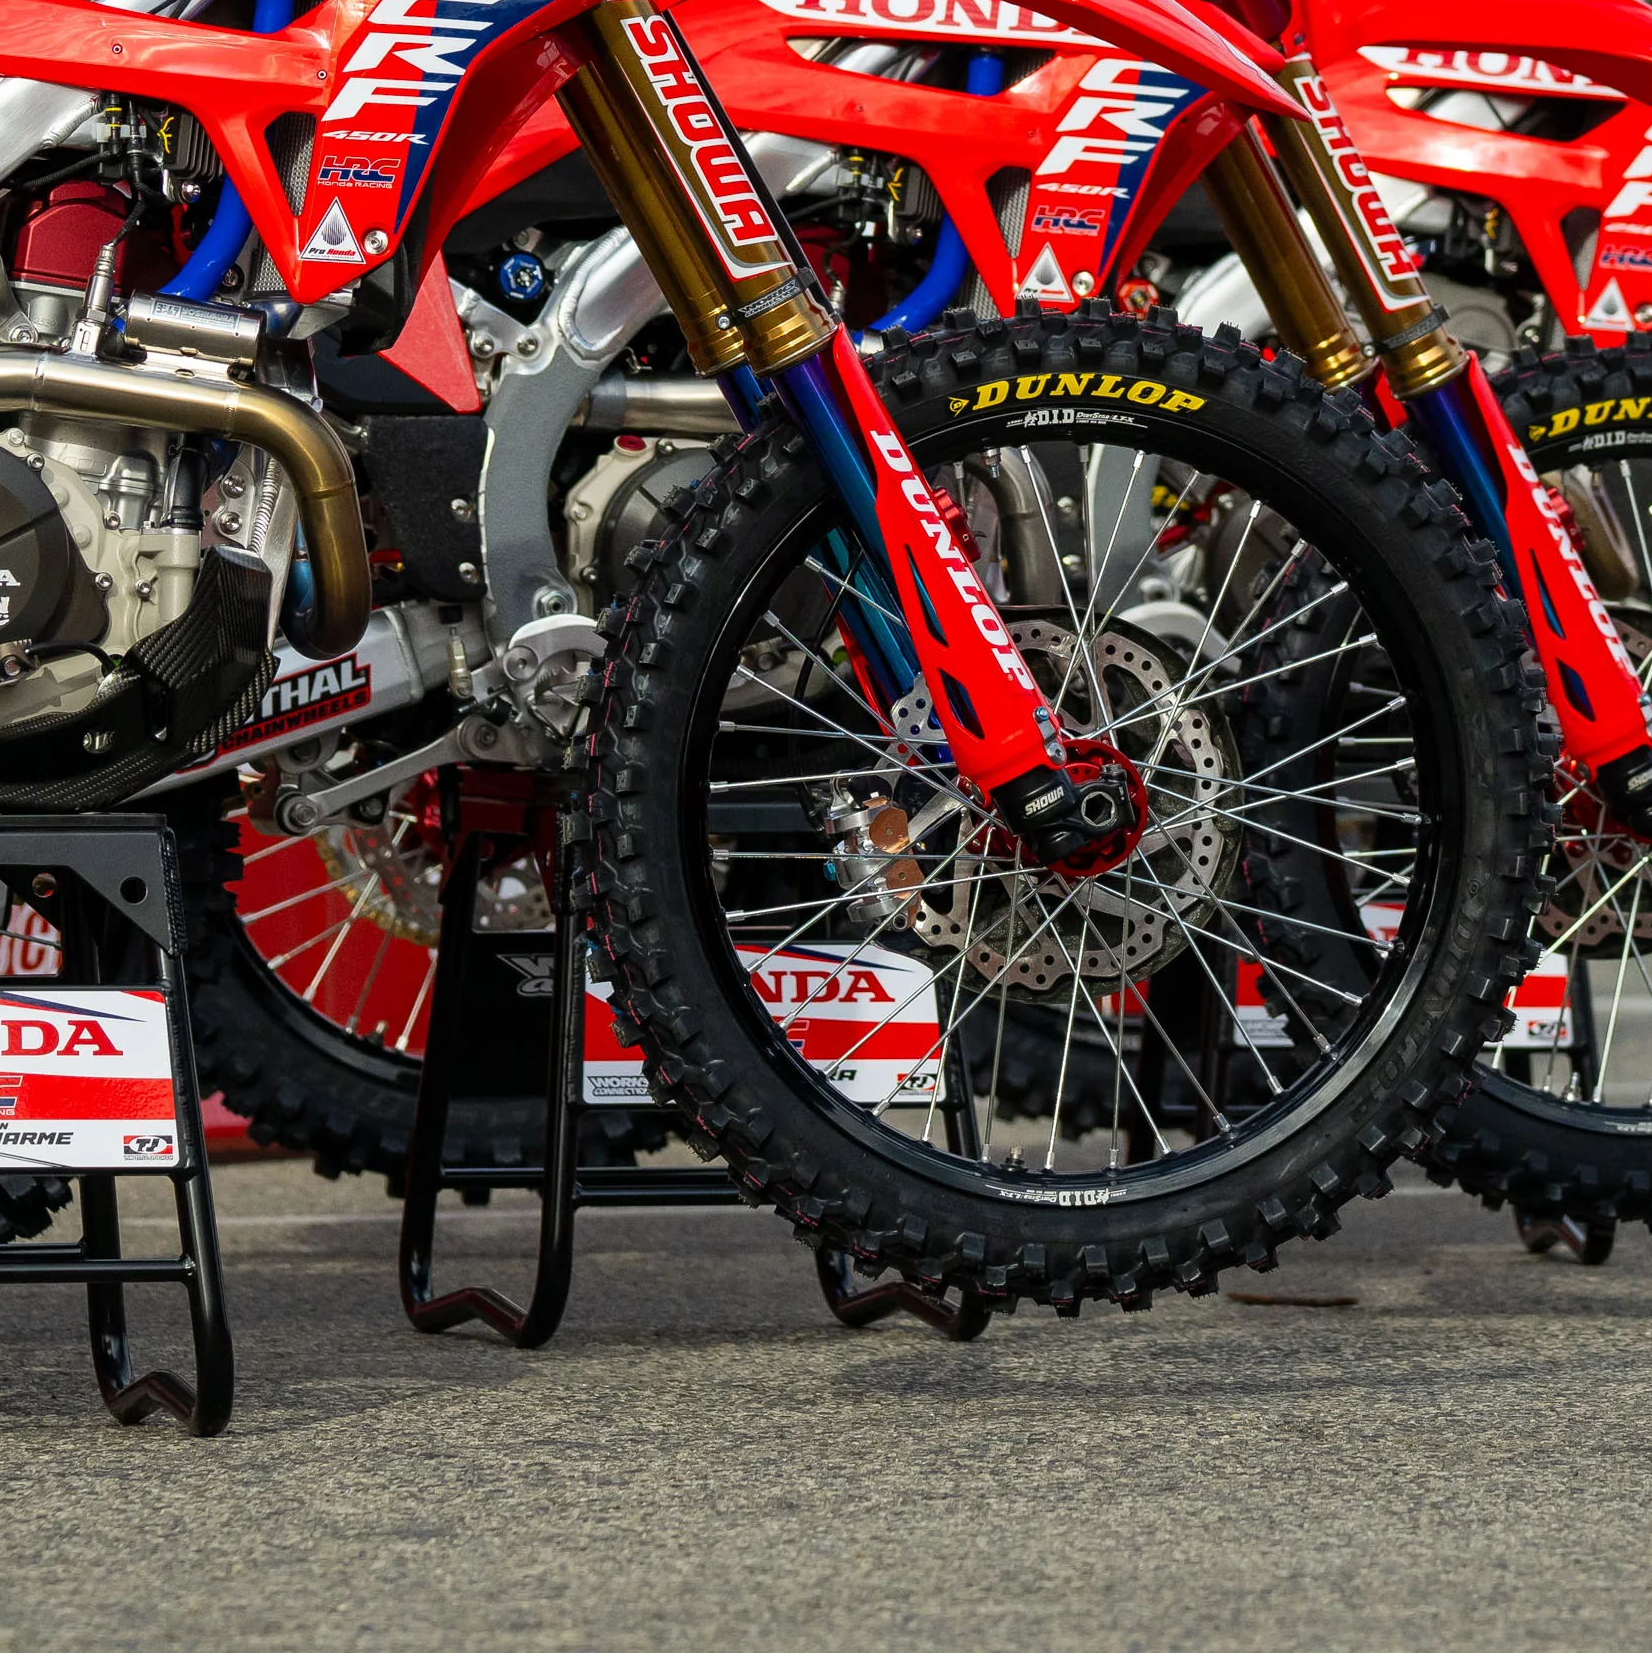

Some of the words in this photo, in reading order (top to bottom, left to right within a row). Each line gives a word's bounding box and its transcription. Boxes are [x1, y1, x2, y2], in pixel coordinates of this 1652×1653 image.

[322, 130, 429, 145] 450R
[621, 15, 777, 247] SHOWA
[1035, 58, 1189, 176] CRF
[318, 155, 401, 183] HRC
[1294, 75, 1423, 281] SHOWA
[308, 247, 326, 255] Pro
[326, 248, 356, 257] Honda
[972, 373, 1206, 414] DUNLOP
[869, 429, 1035, 692] DUNLOP
[1507, 443, 1641, 680] DUNLOP
[1024, 786, 1065, 816] SHOWA
[135, 1138, 161, 1152] TJ
